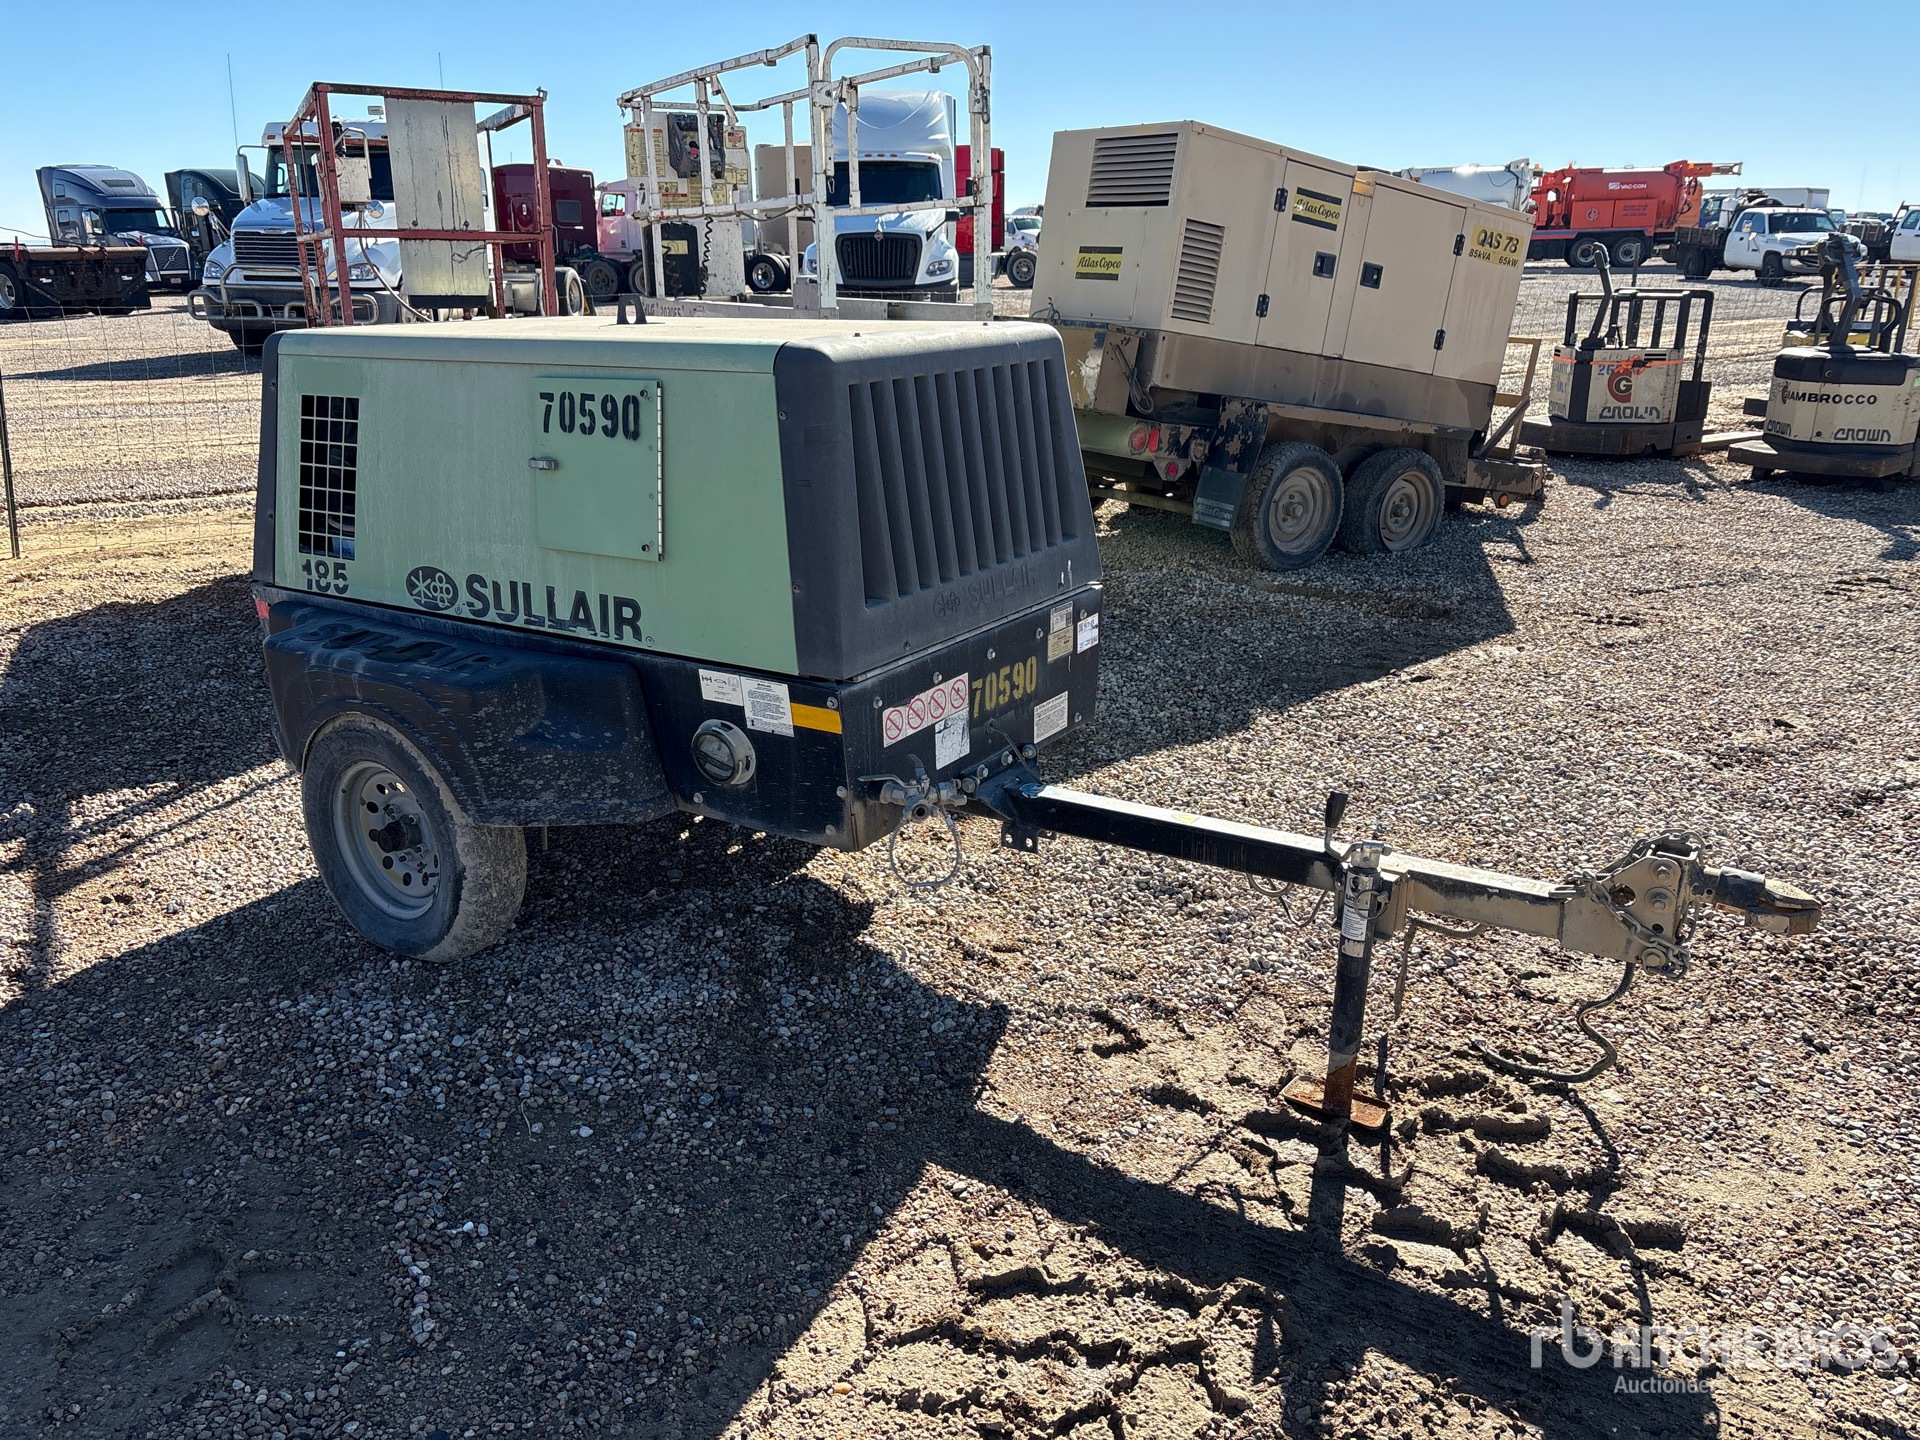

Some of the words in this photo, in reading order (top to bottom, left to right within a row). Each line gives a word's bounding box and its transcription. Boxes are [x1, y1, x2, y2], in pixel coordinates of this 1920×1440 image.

[1317, 204, 1340, 219] Copco
[1477, 228, 1503, 250] QAS
[1076, 256, 1099, 268] Atlas
[1099, 257, 1122, 270] Copco
[1469, 248, 1491, 261] 85kVA
[1498, 255, 1519, 268] 65kW
[1783, 389, 1878, 405] GIAMBROCCO
[539, 391, 640, 441] 70590
[1766, 419, 1792, 437] CROWN
[1833, 427, 1892, 442] CROWN
[301, 558, 350, 595] 185
[463, 572, 643, 643] SULLAIR
[971, 655, 1038, 718] 70590
